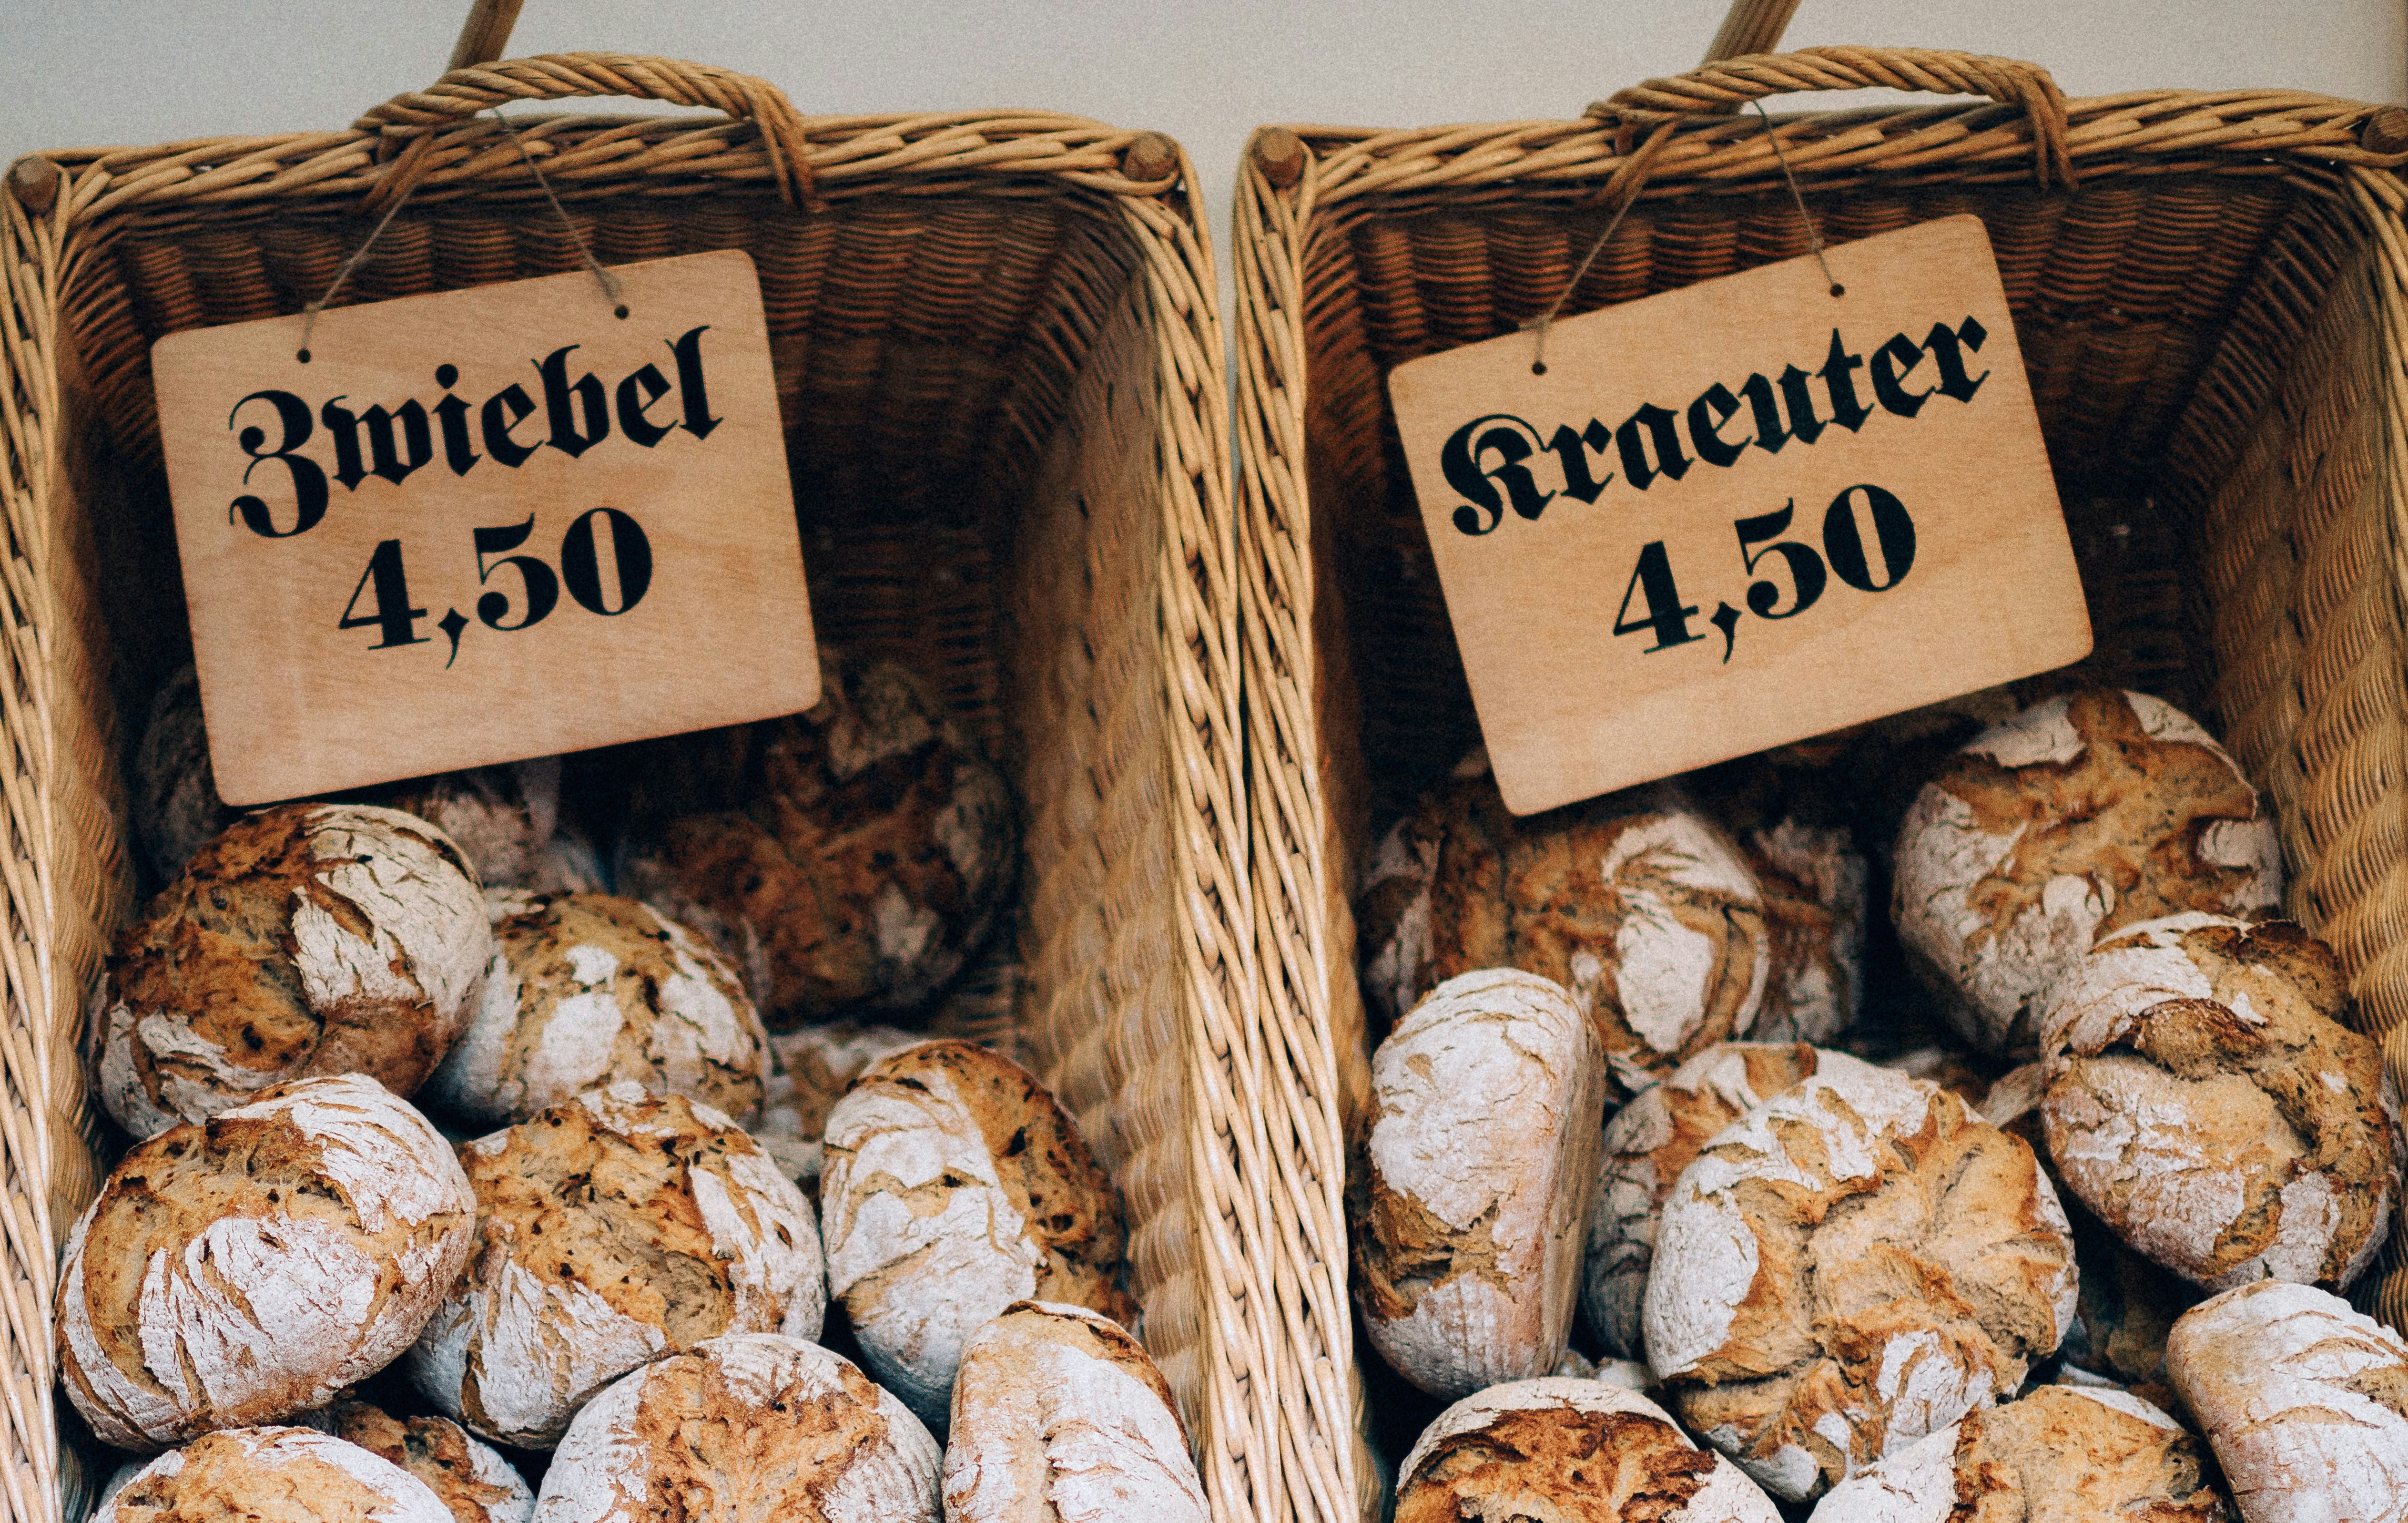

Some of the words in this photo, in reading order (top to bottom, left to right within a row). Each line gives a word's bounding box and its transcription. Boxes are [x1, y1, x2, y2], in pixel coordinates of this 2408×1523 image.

[227, 325, 724, 539] Zwiebel
[1440, 315, 1991, 536] Kraeuter
[338, 506, 653, 670] 4,50
[1613, 483, 1916, 665] 4,50
